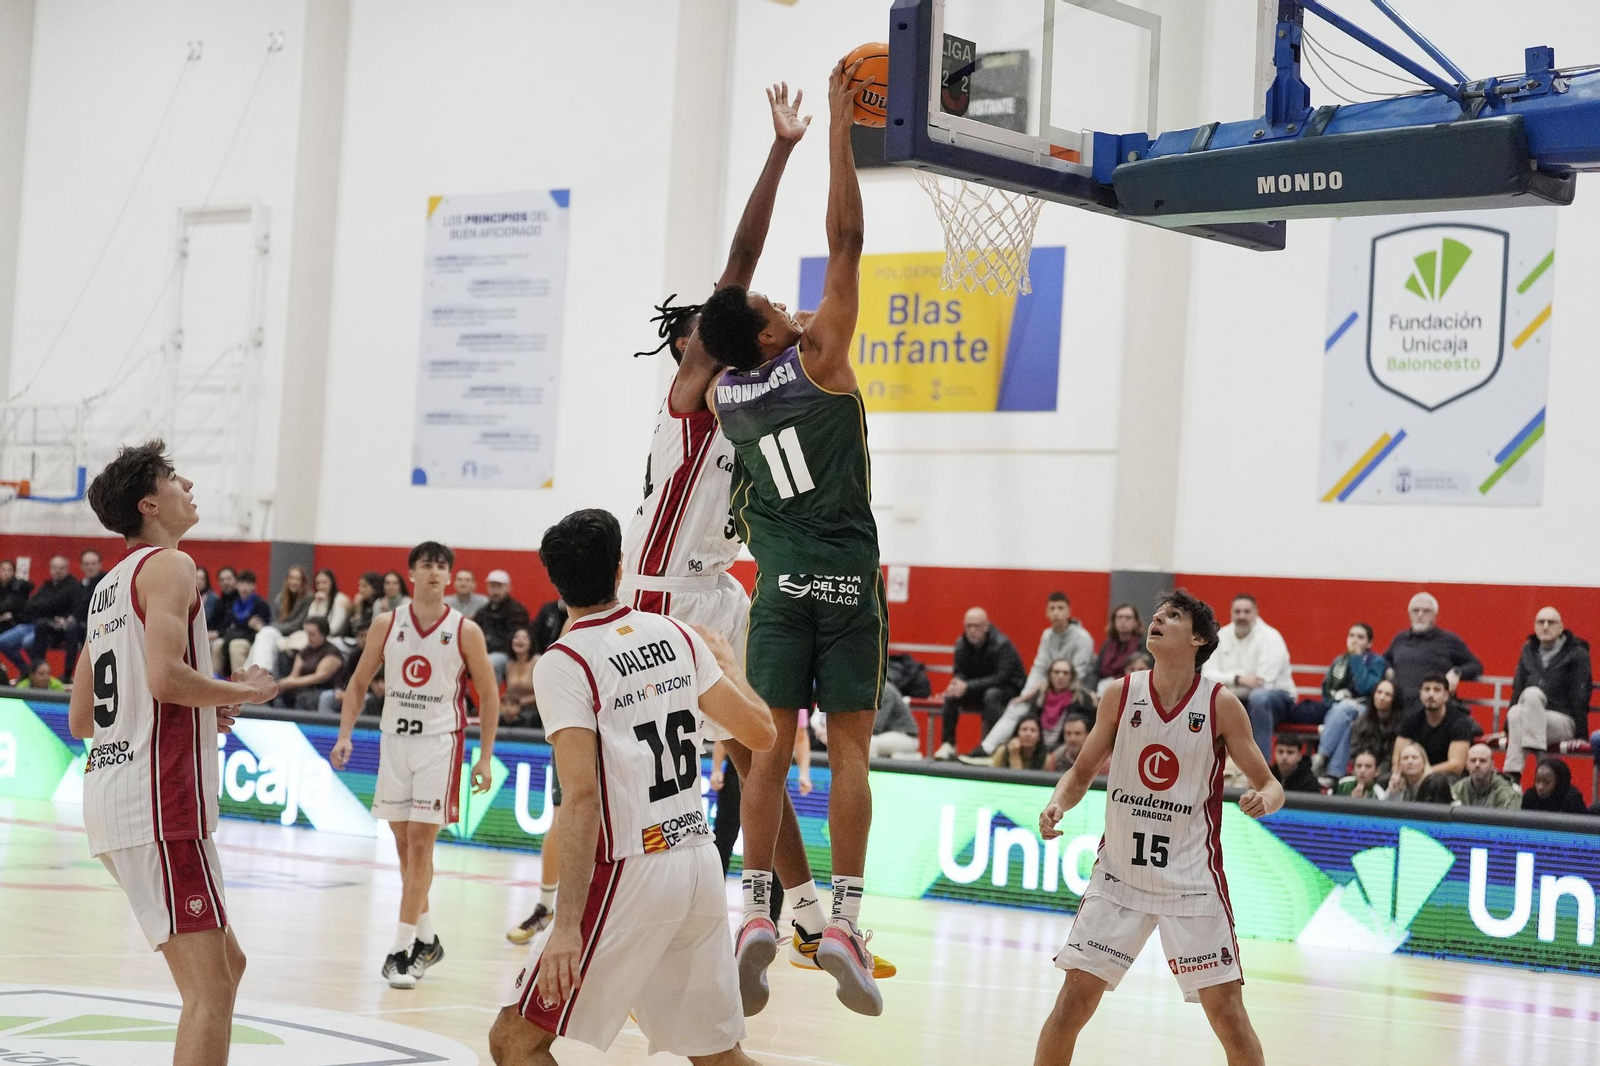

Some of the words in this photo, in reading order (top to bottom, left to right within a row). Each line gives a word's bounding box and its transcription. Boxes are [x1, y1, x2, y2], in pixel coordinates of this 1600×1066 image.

[1257, 171, 1343, 195] MONDO
[443, 215, 462, 227] LOS
[464, 211, 528, 225] PRINCIPIOS
[529, 210, 549, 222] DEL
[450, 227, 477, 241] BUEN
[479, 224, 542, 238] AFICIONADO
[889, 293, 962, 326] Blas
[1389, 311, 1482, 331] Fundación
[858, 330, 988, 365] Infante
[1402, 335, 1468, 356] Unicaja
[1387, 356, 1481, 372] Baloncesto
[758, 425, 816, 500] 11
[811, 590, 858, 606] MÁLAGA
[812, 580, 836, 592] DEL
[838, 583, 860, 596] SOL
[608, 639, 677, 677] VALERO
[93, 648, 119, 729] 9
[614, 694, 634, 710] AIR
[637, 675, 692, 701] HORIZONT
[396, 717, 423, 735] 22
[633, 709, 696, 803] 16
[1111, 788, 1194, 815] Casademon
[1131, 808, 1172, 822] ZARAGOZA
[666, 832, 681, 847] DE
[1131, 832, 1170, 868] 15
[793, 898, 818, 910] MERCURY
[832, 885, 846, 915] UNICAJA
[1087, 940, 1134, 964] azulmarino
[1178, 952, 1217, 964] Zaragoza
